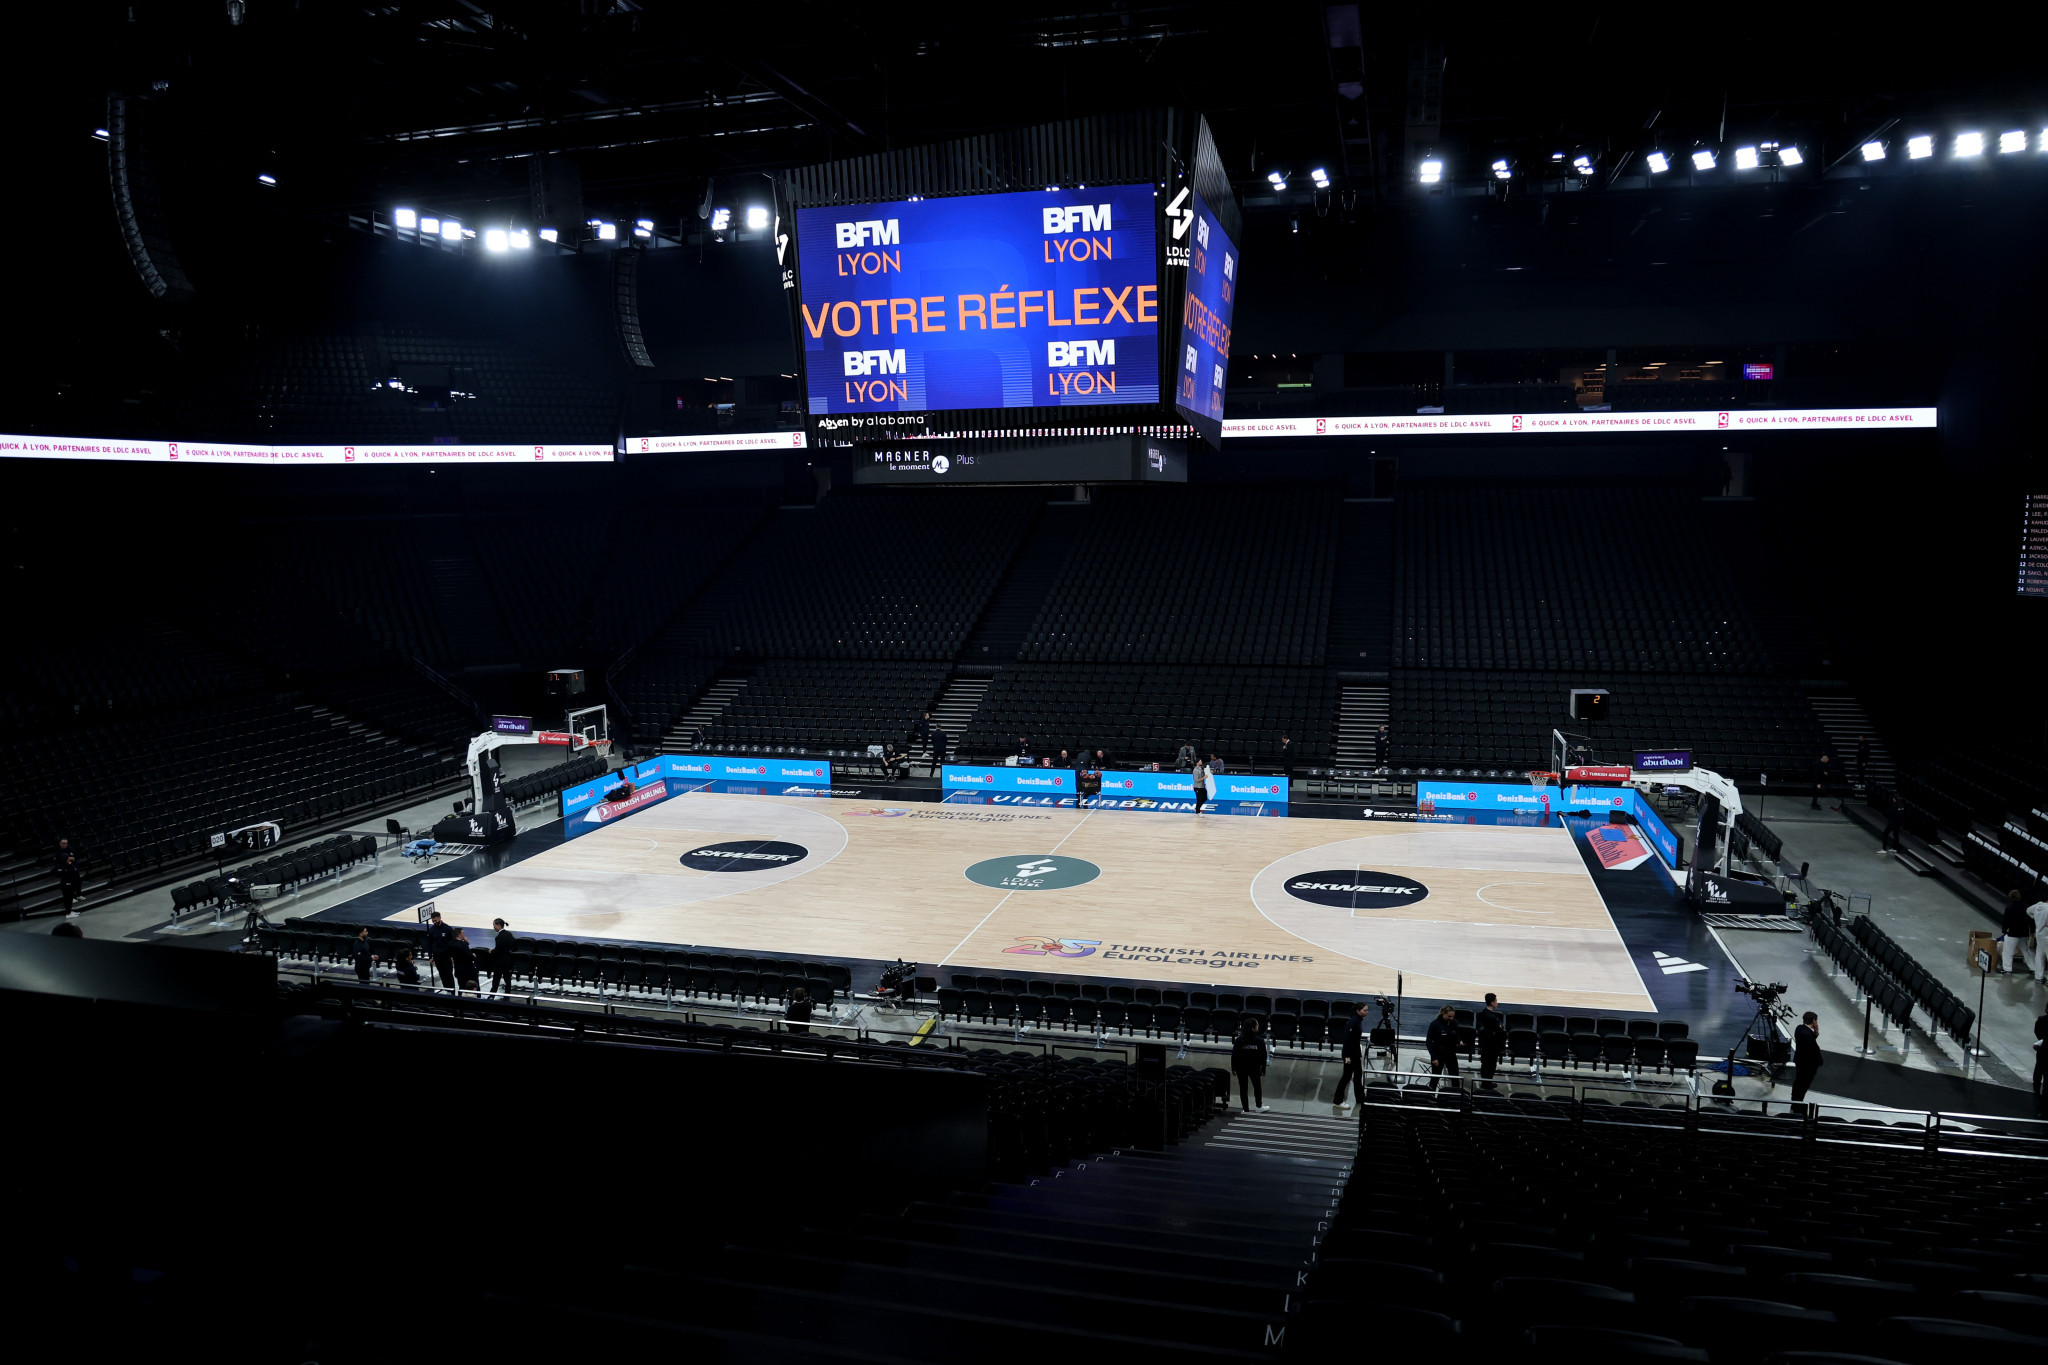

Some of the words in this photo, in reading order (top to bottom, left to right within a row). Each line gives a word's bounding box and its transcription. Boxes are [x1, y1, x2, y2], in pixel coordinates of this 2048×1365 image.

[1043, 204, 1112, 234] BFM
[836, 219, 900, 249] BFM
[1044, 237, 1112, 263] LYON
[1167, 247, 1190, 258] LDLC
[838, 251, 901, 276] LYON
[1167, 258, 1190, 268] ASVEL
[802, 296, 946, 339] VOTRE
[959, 285, 1158, 330] RÉFLEXE
[1048, 340, 1116, 367] BFM
[844, 349, 907, 376] BFM
[1049, 372, 1116, 395] LYON
[845, 380, 908, 403] LYON
[818, 418, 848, 430] Absen
[852, 416, 864, 428] by
[866, 416, 924, 426] alabama
[53, 444, 100, 452] PARTENAIRES
[874, 451, 930, 462] MAGNER
[956, 454, 974, 464] Plus
[1594, 695, 1600, 703] 2
[672, 764, 702, 772] DenizBank
[726, 766, 757, 774] DenizBank
[782, 768, 814, 776] DenizBank
[949, 774, 984, 783] DenizBank
[1017, 777, 1052, 786] DenizBank
[1231, 785, 1269, 794] DenizBank
[1426, 792, 1466, 800] DenizBank
[613, 797, 640, 811] TURKISH
[640, 785, 666, 800] AIRLINES
[1497, 794, 1538, 803] DenizBank
[909, 814, 1013, 822] EuroLeague
[1291, 882, 1419, 895] SKWEEK
[1103, 952, 1260, 968] EuroLeague
[1110, 944, 1204, 956] TURKISH
[1212, 951, 1314, 963] AIRLINES
[1297, 1271, 1308, 1286] K
[1264, 1324, 1286, 1348] M
